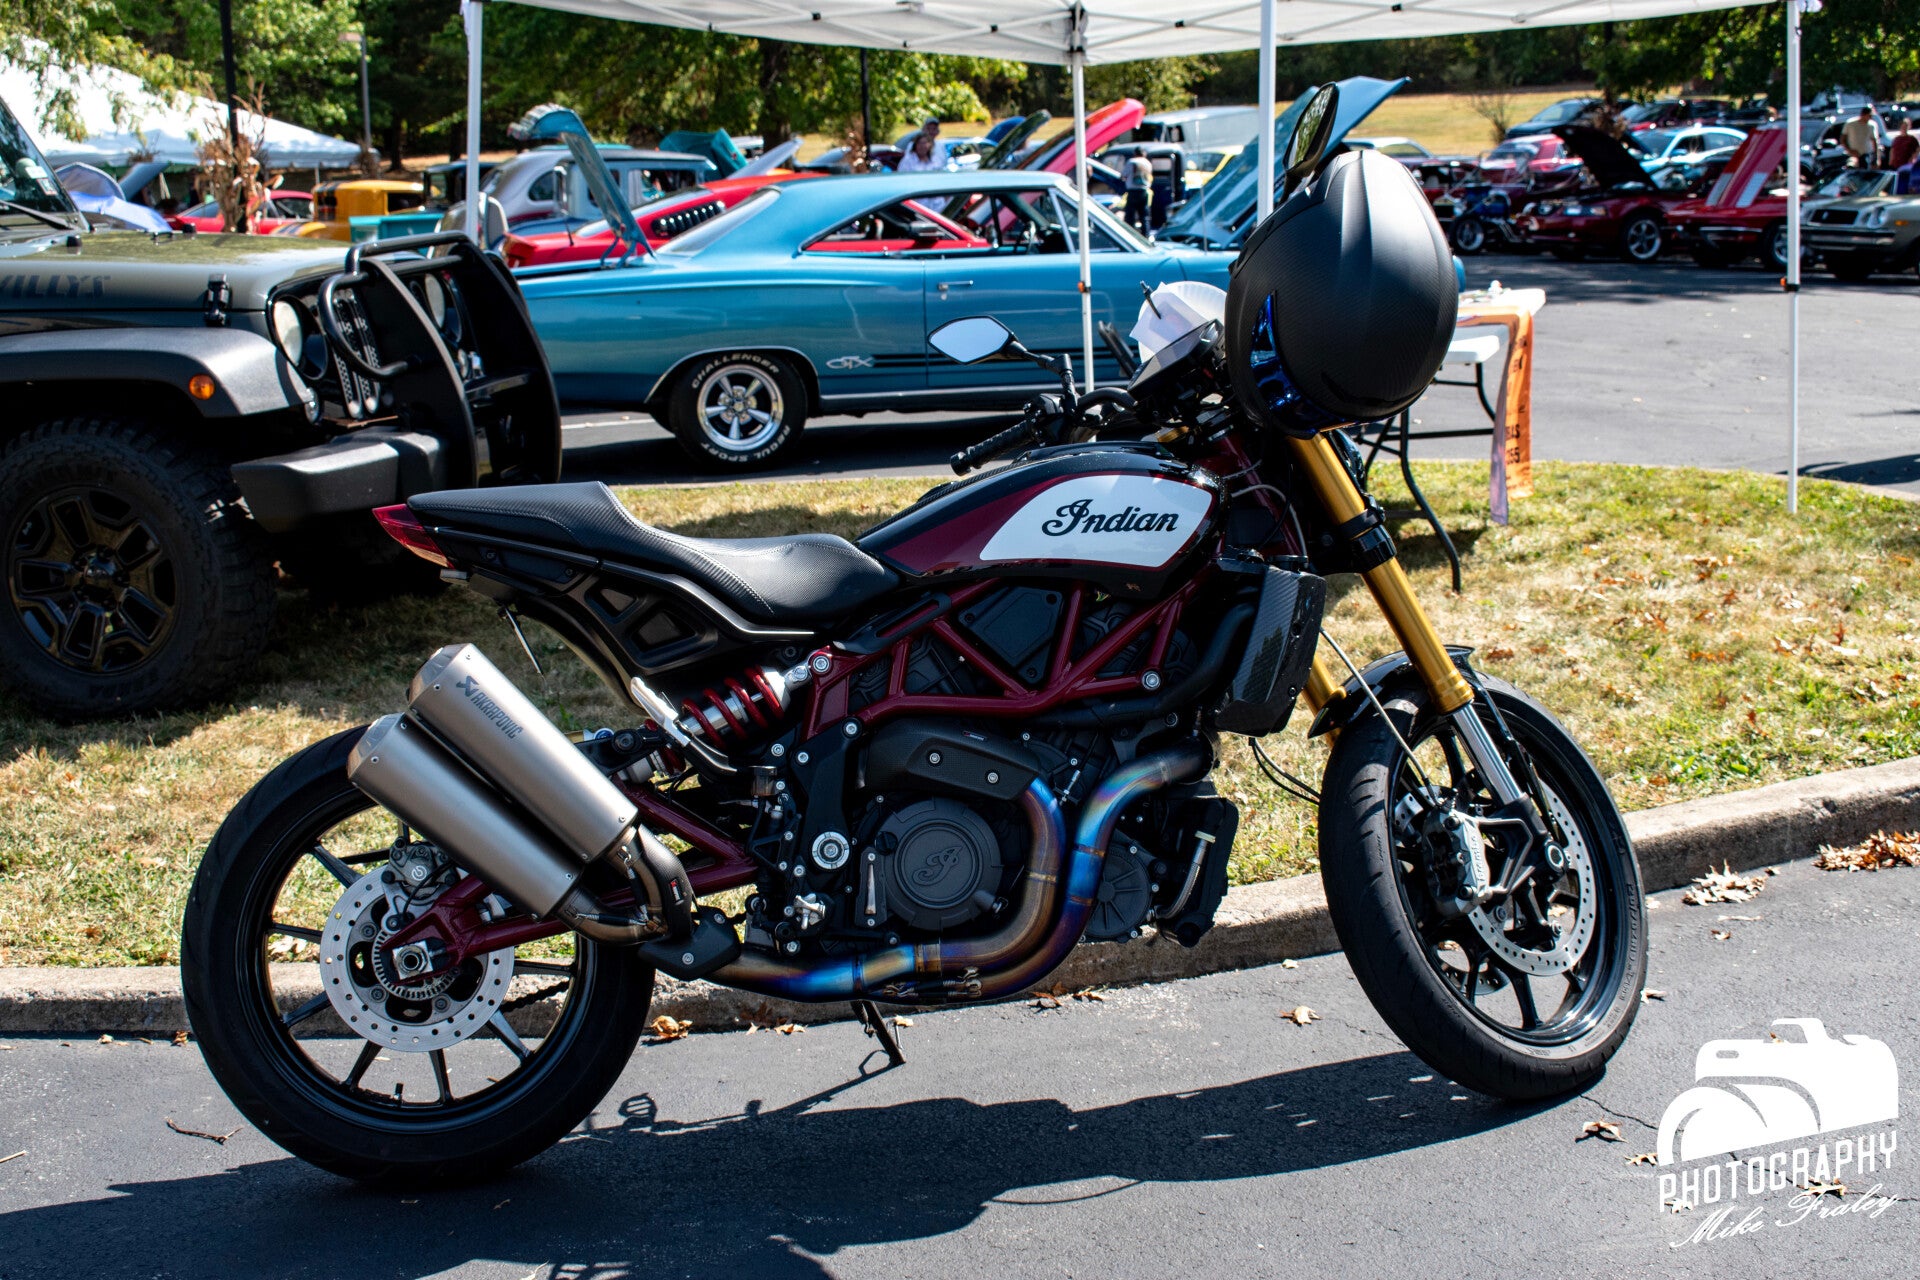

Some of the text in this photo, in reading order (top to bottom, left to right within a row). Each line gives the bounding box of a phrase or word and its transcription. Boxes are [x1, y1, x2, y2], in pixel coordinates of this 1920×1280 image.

[692, 353, 779, 389] CHALLENGER
[701, 442, 748, 462] SPORT
[1041, 499, 1179, 536] Indian
